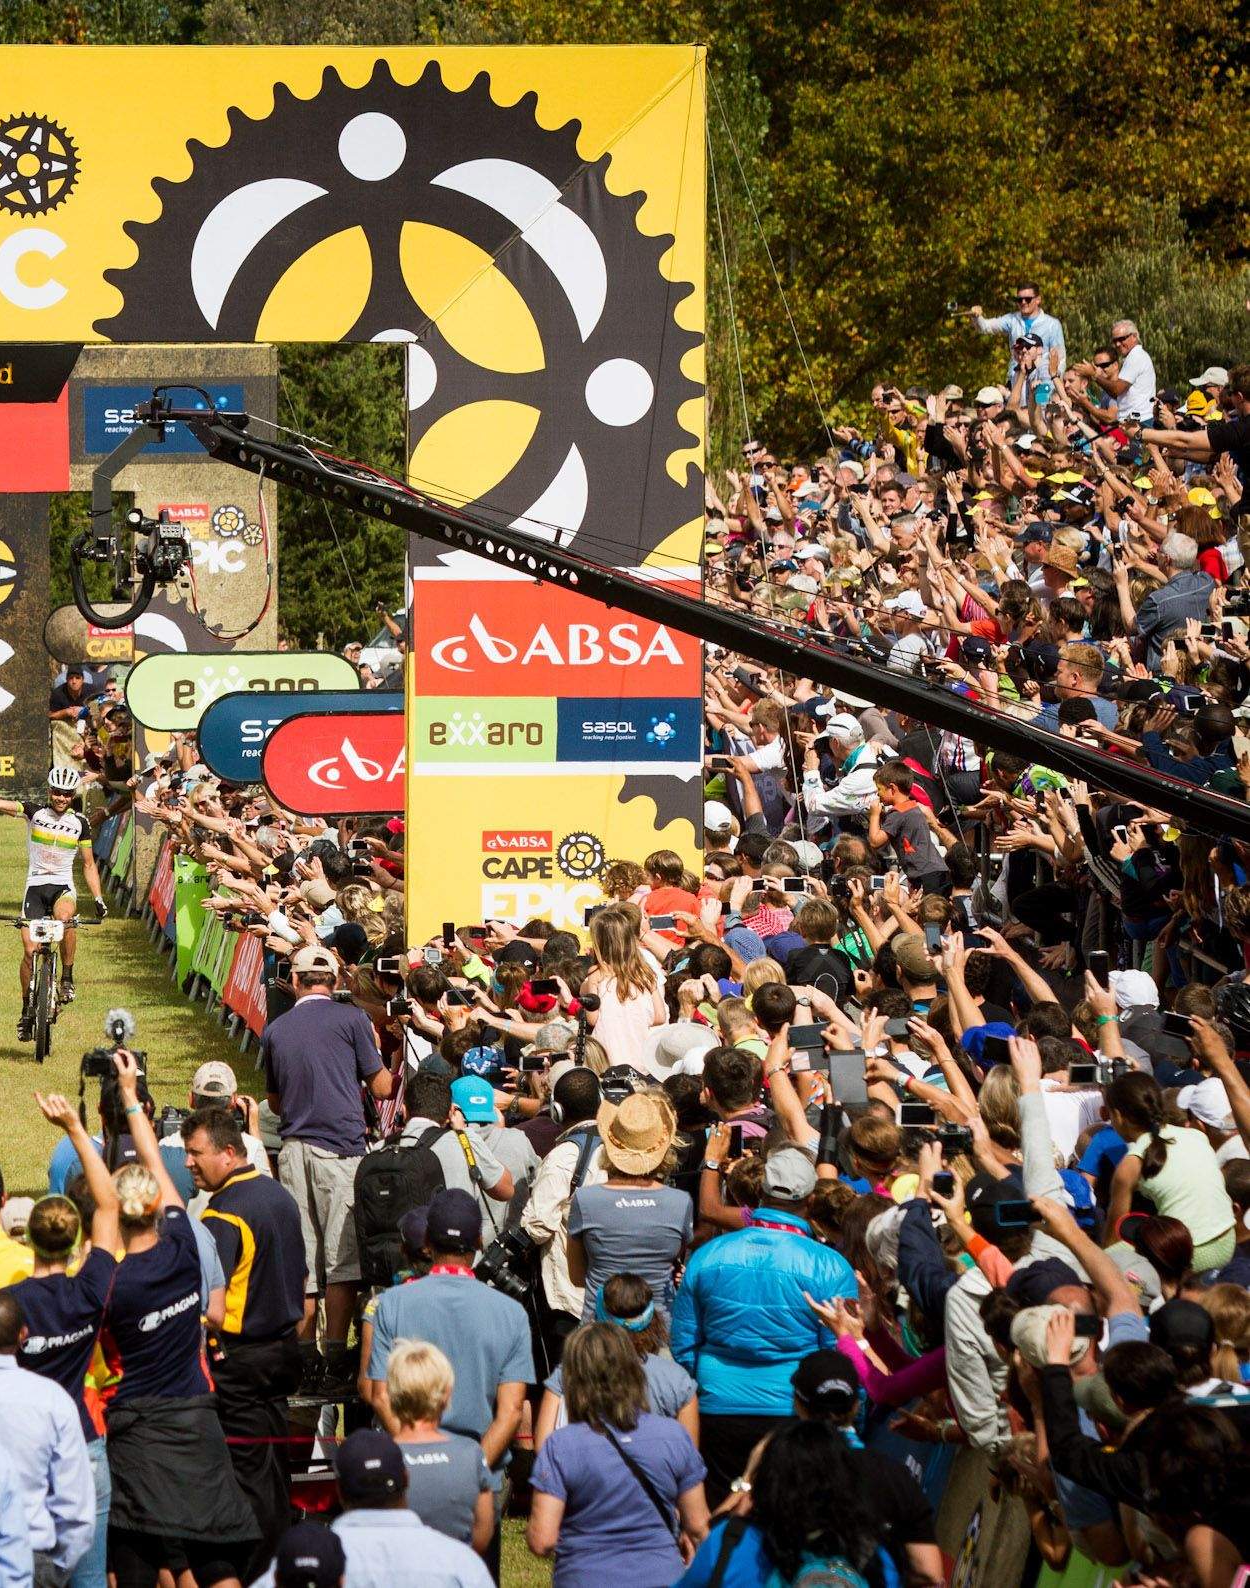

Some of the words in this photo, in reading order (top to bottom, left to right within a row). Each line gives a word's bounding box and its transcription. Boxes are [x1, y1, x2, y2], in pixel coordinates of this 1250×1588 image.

[191, 540, 246, 574] PIC
[86, 639, 133, 658] CAP
[520, 622, 684, 666] ABSA
[428, 711, 543, 747] exxaro
[508, 836, 548, 848] ABSA
[481, 857, 553, 880] CAPE
